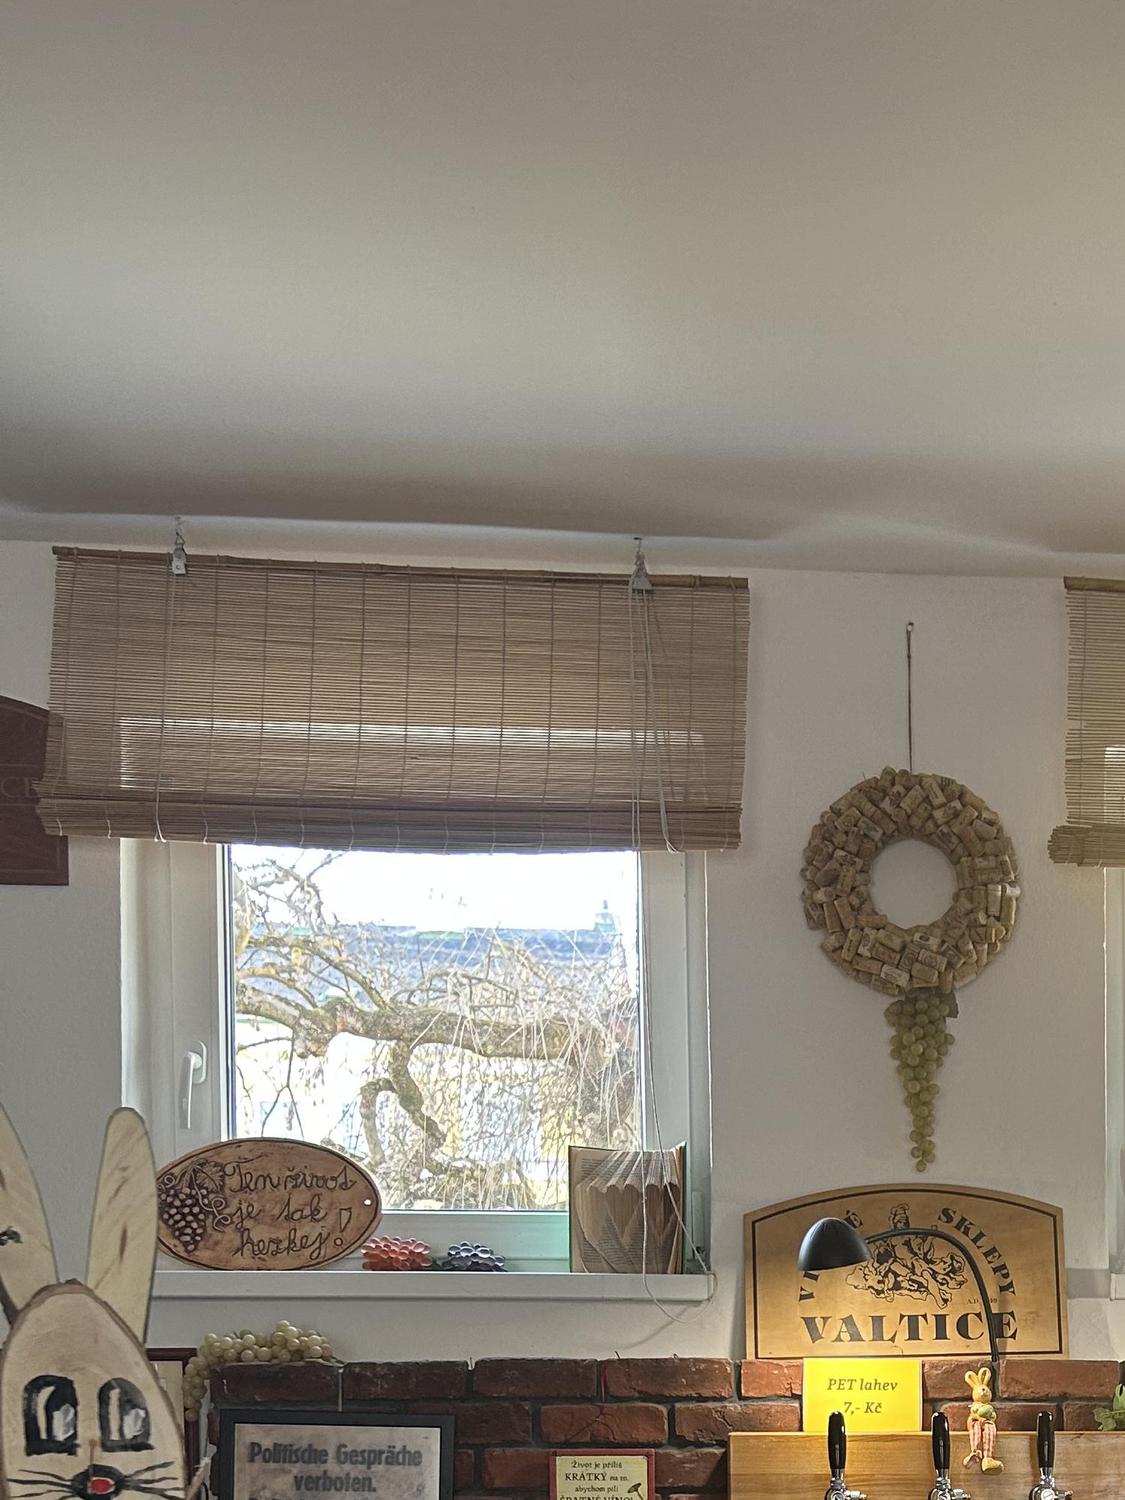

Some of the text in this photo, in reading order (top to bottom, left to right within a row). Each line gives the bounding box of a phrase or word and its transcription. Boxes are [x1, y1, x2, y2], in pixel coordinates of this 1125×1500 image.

[232, 1194, 328, 1229] je tak
[938, 1207, 1017, 1297] SKLEPY
[800, 1311, 1018, 1344] VALTICE
[827, 1378, 898, 1391] PET lahev
[843, 1401, 882, 1415] 7,- Kč
[247, 1442, 423, 1469] Politische Gespräche
[571, 1460, 592, 1468] Život
[594, 1461, 600, 1469] je
[294, 1470, 377, 1492] verboten.
[565, 1471, 607, 1481] KRÁTKÝ
